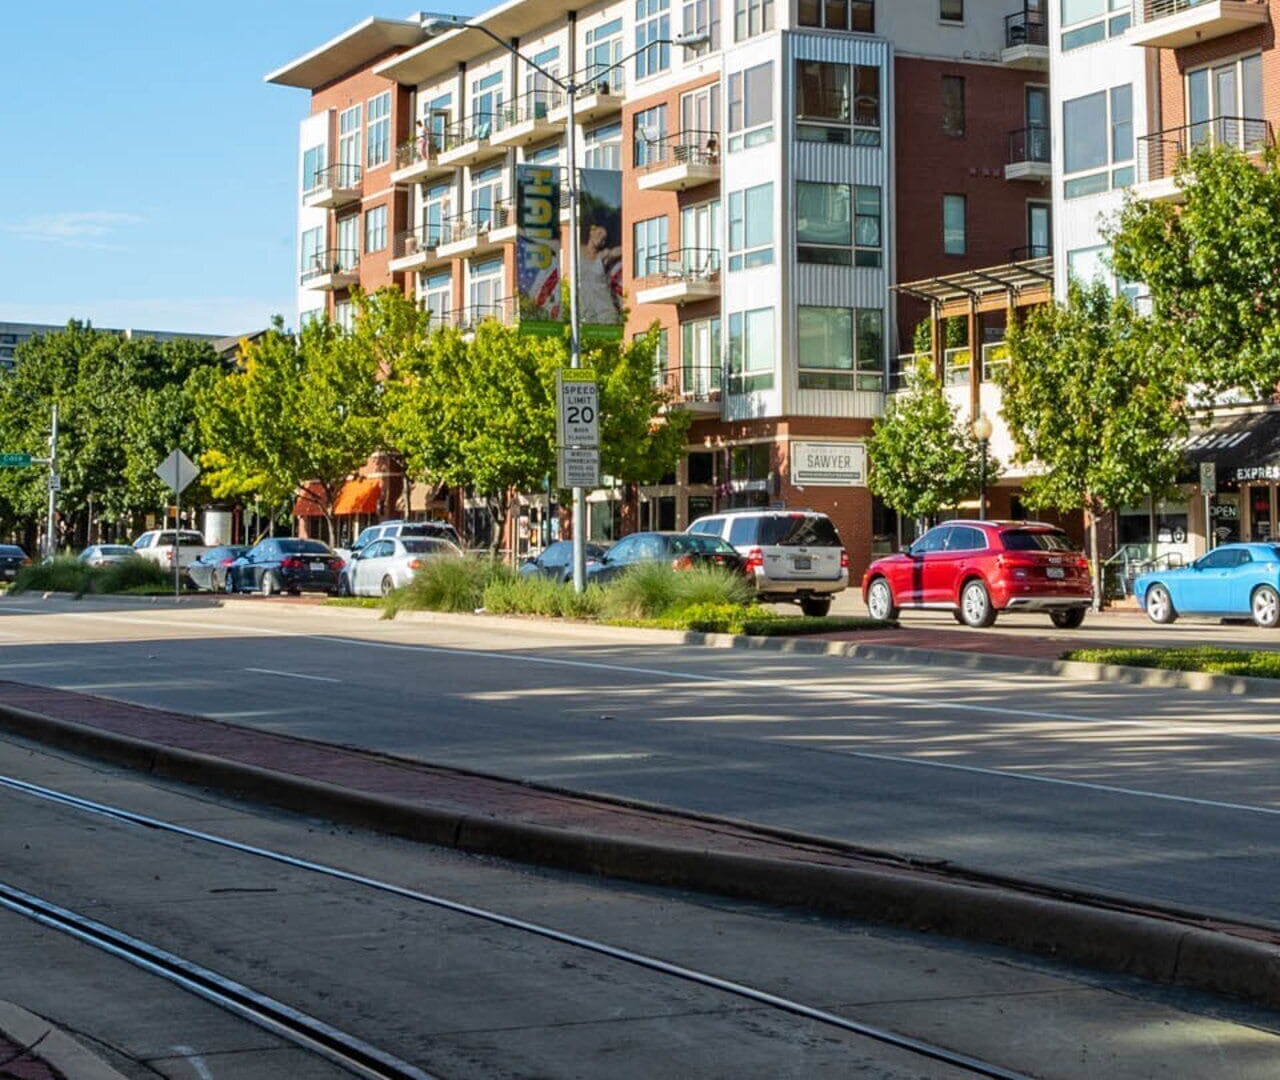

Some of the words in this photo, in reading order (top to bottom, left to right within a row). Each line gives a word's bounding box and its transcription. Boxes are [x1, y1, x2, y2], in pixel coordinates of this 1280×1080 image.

[564, 385, 596, 394] SPEED
[567, 396, 592, 405] LIMIT
[567, 406, 594, 424] 20
[807, 454, 850, 469] SAWYER
[1210, 506, 1237, 518] OPEN
